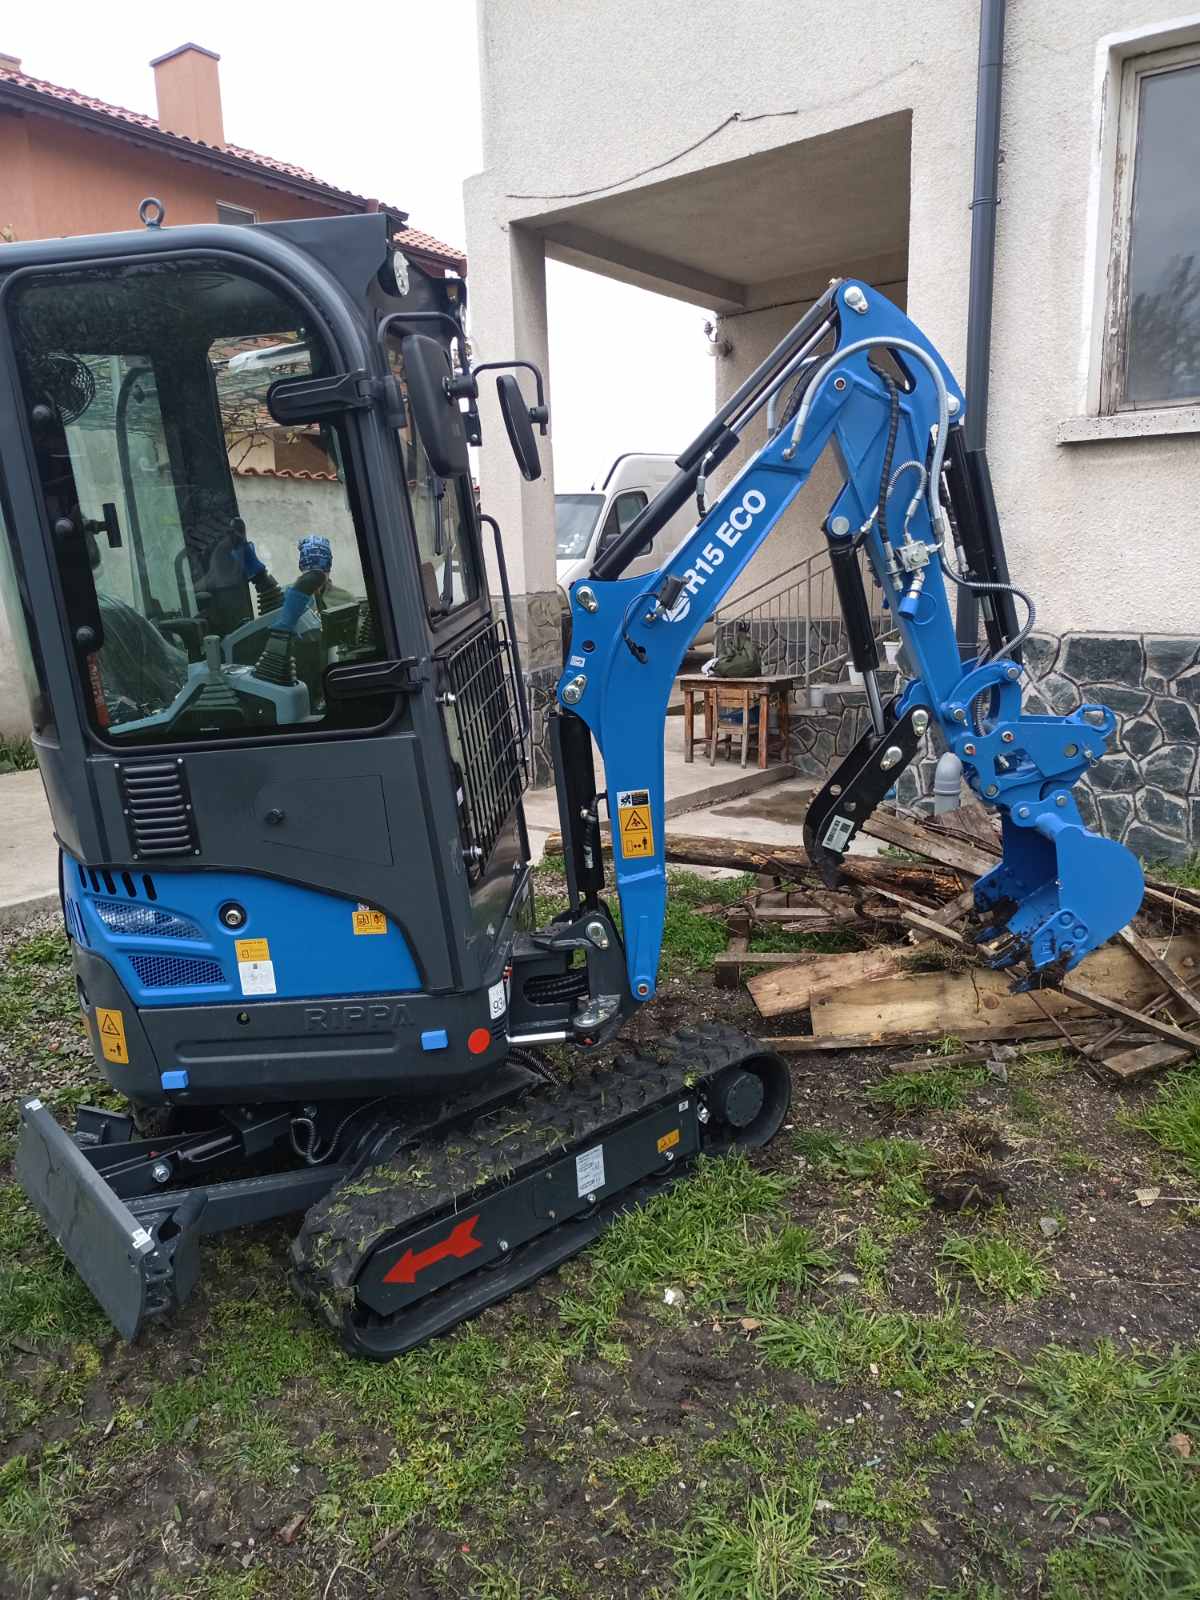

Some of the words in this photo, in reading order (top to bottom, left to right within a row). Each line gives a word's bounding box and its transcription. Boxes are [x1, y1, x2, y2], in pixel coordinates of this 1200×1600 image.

[683, 542, 725, 595] R15
[715, 489, 767, 548] ECO
[304, 1003, 416, 1031] RIPPA
